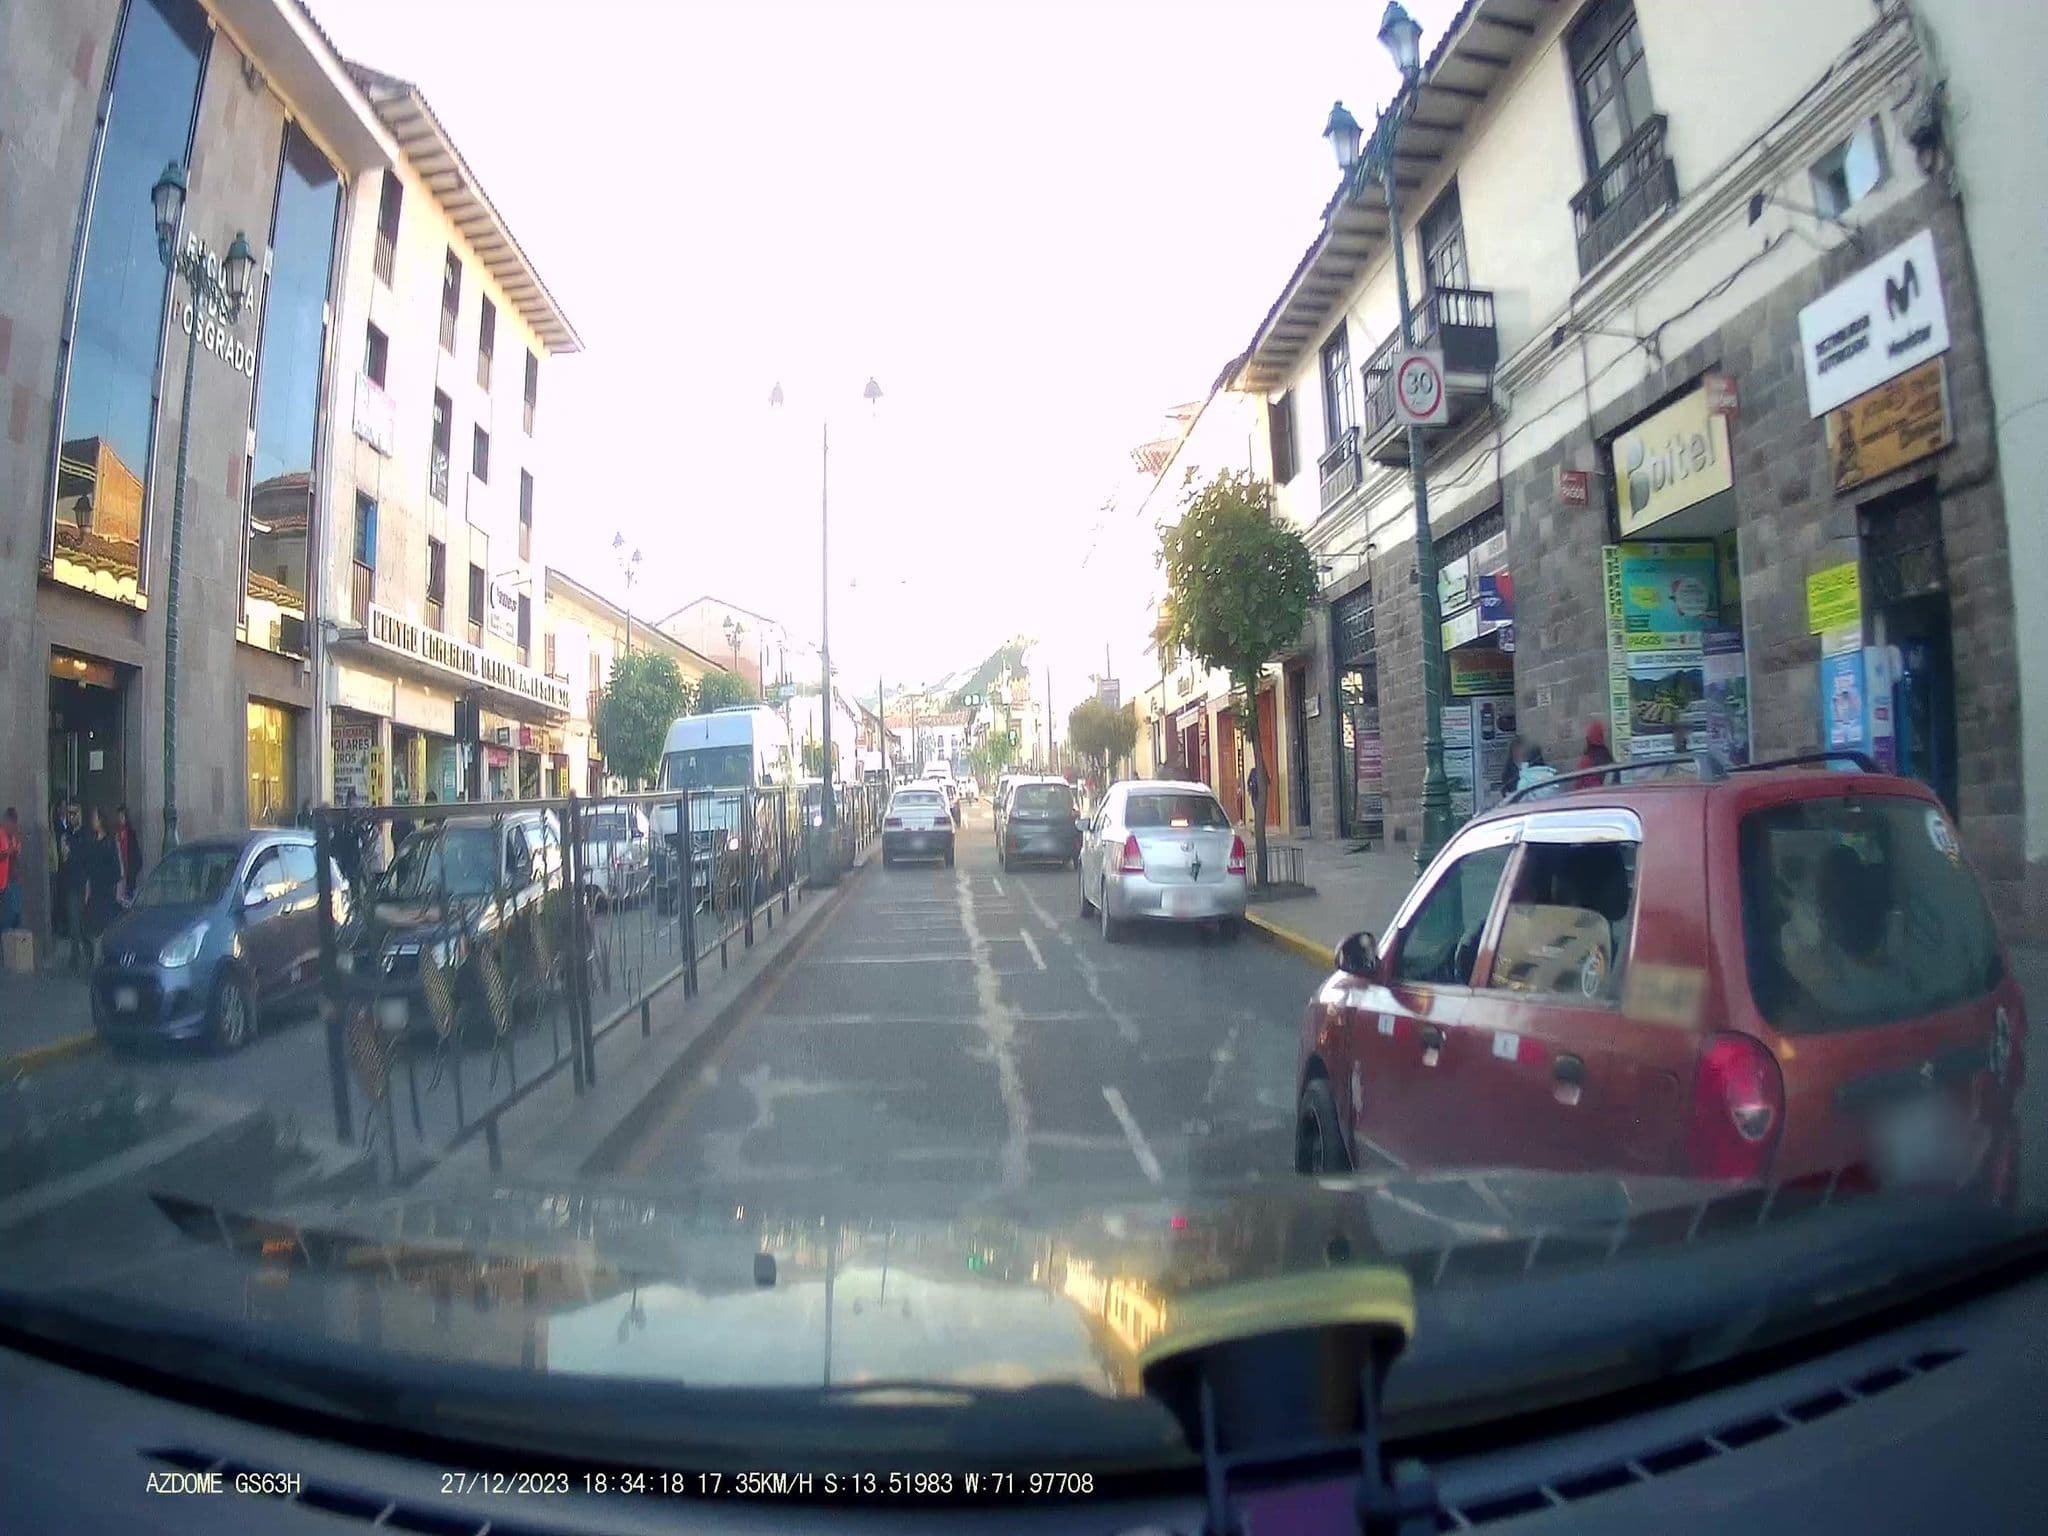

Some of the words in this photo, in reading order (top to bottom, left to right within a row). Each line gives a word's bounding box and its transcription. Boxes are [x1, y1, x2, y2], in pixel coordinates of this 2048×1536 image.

[1407, 371, 1433, 396] 30
[373, 609, 418, 653] CENTRO
[422, 631, 479, 676] COMERCIAL
